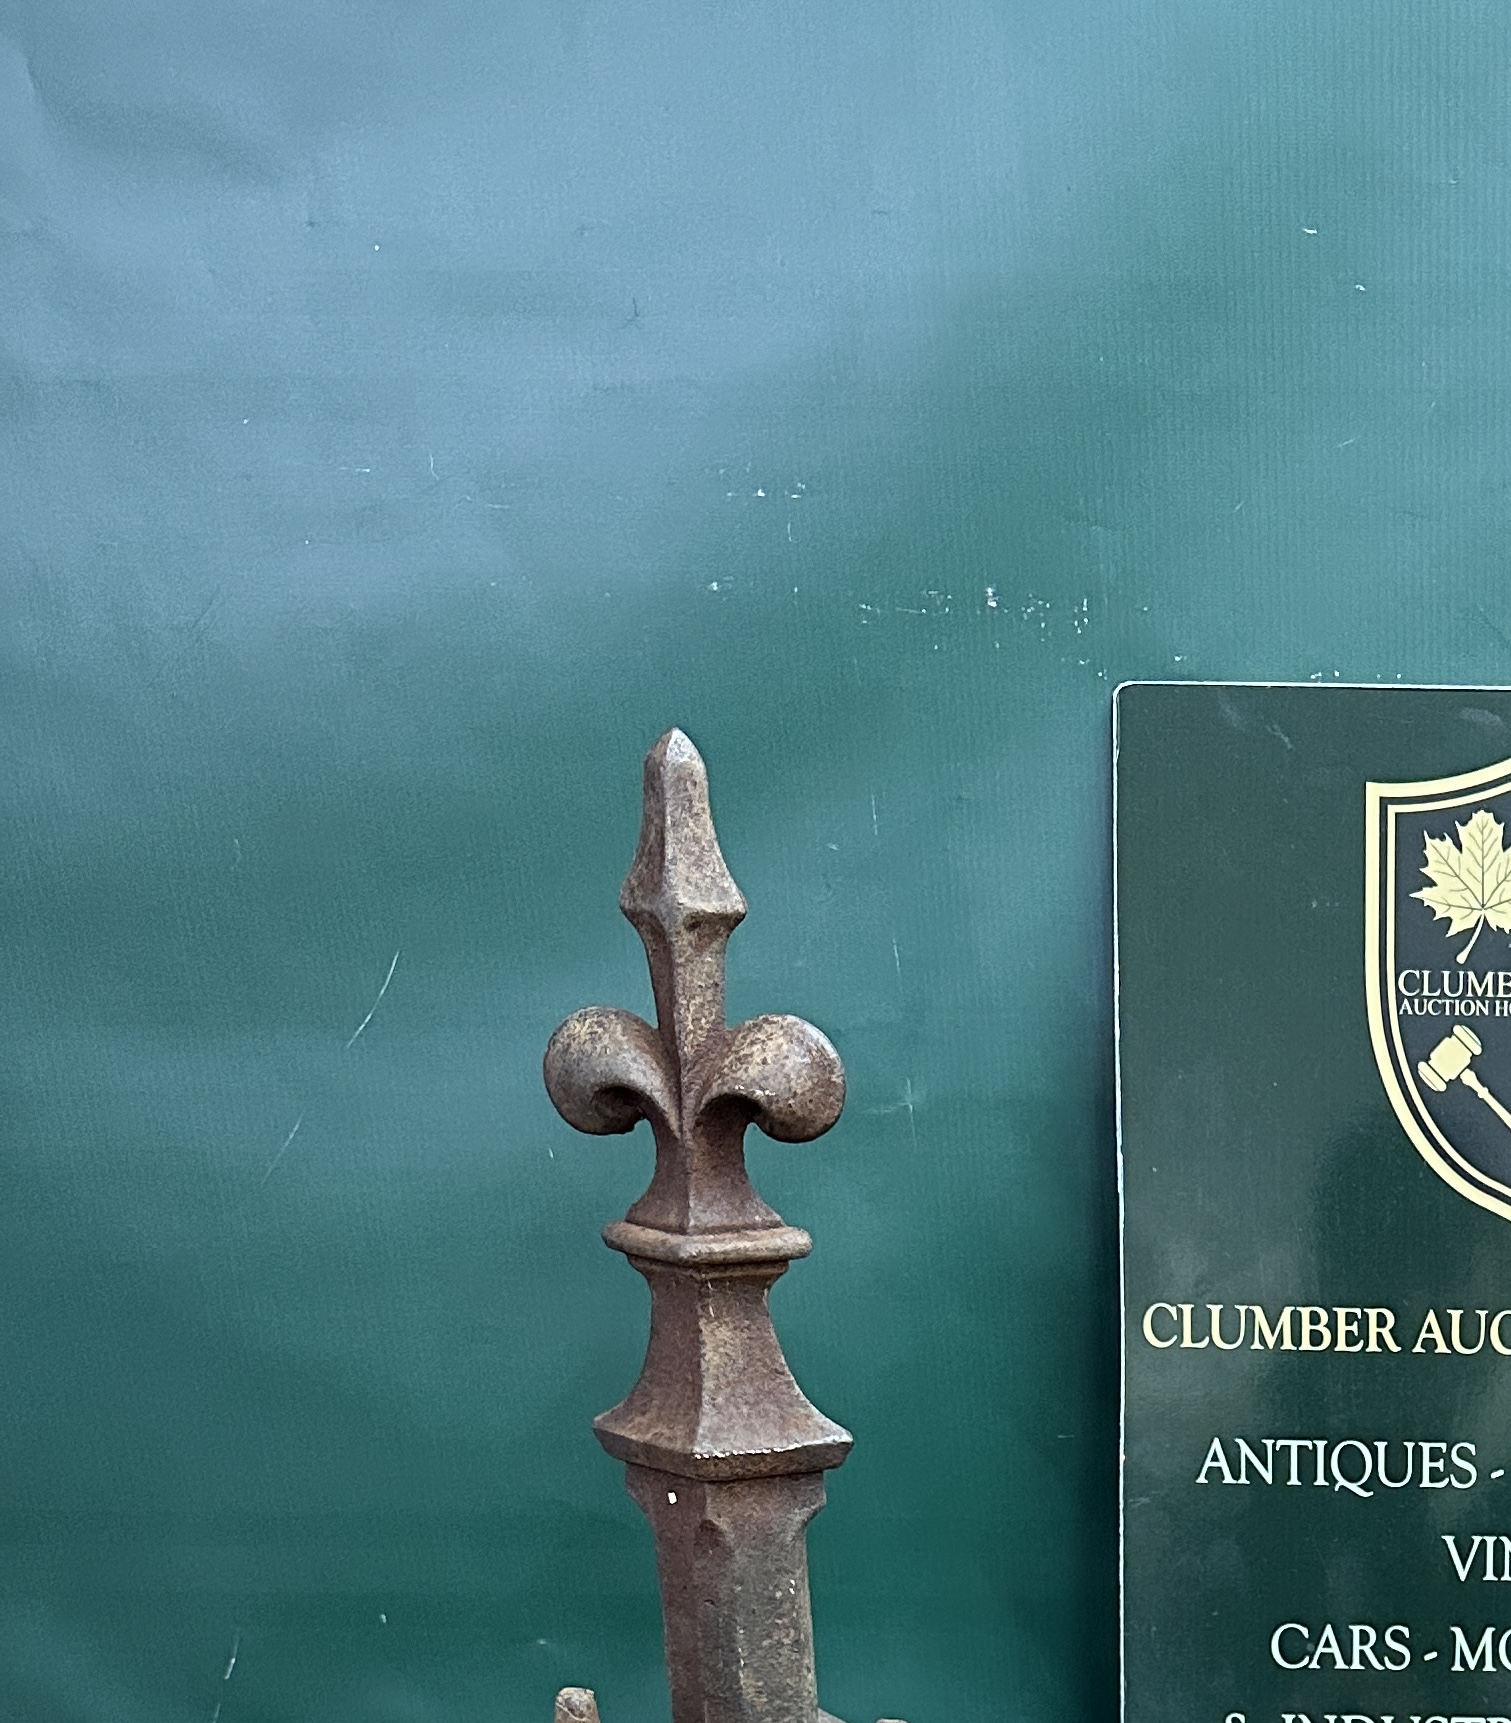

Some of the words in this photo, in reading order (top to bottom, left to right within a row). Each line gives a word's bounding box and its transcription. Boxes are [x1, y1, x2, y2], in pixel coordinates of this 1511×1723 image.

[1399, 998, 1489, 1016] AUCTION
[1142, 1302, 1402, 1354] CLUMBER
[1197, 1438, 1477, 1498] ANTIQUES
[1271, 1622, 1412, 1673] CARS
